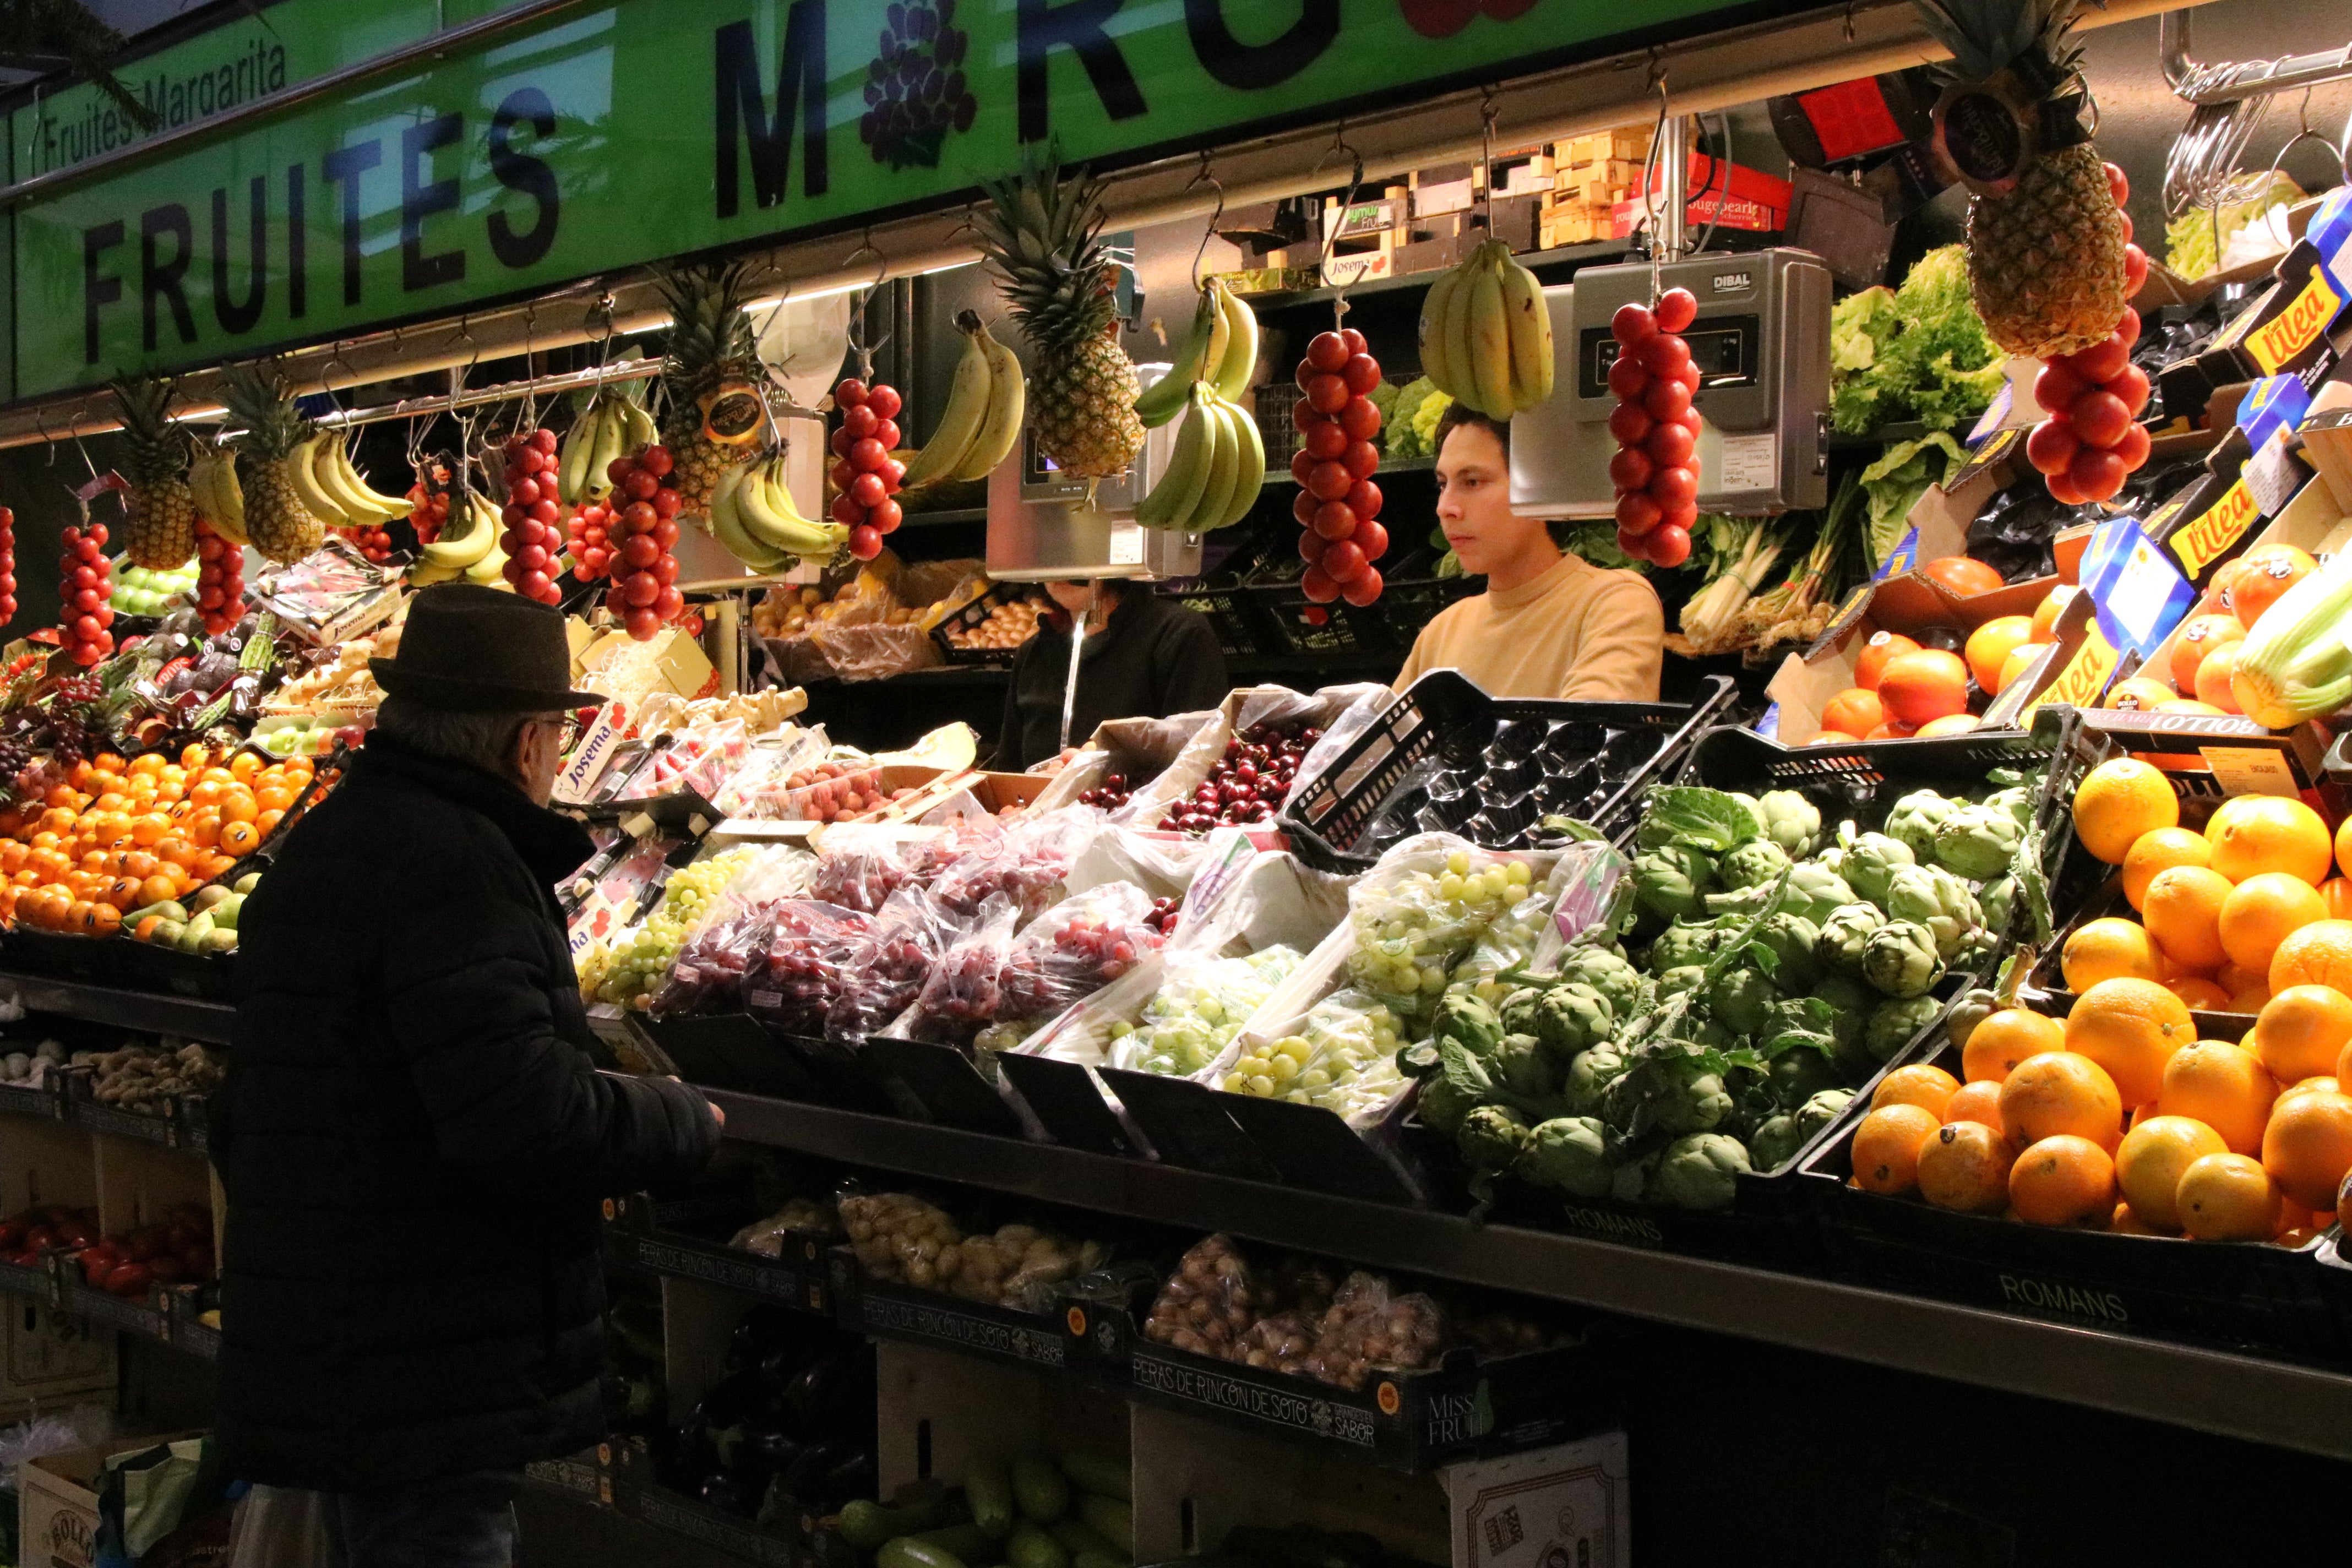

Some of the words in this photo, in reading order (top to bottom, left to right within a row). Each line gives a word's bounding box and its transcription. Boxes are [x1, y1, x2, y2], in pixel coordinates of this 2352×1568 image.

[43, 111, 134, 174] Fruites
[84, 86, 560, 365] FRUITES
[1713, 273, 1750, 288] DIBAL
[2163, 716, 2258, 735] BOLLO
[568, 725, 611, 792] Josema
[1564, 1205, 1663, 1241] ROMANS
[1997, 1273, 2130, 1322] ROMANS
[979, 1324, 1009, 1349] SOTO
[1031, 1341, 1064, 1365] SABOR
[1132, 1358, 1174, 1390] PERAS
[1177, 1369, 1194, 1396] DE
[1251, 1389, 1269, 1416] DE
[1271, 1394, 1308, 1424] SOTO
[1335, 1417, 1375, 1445] SABOR
